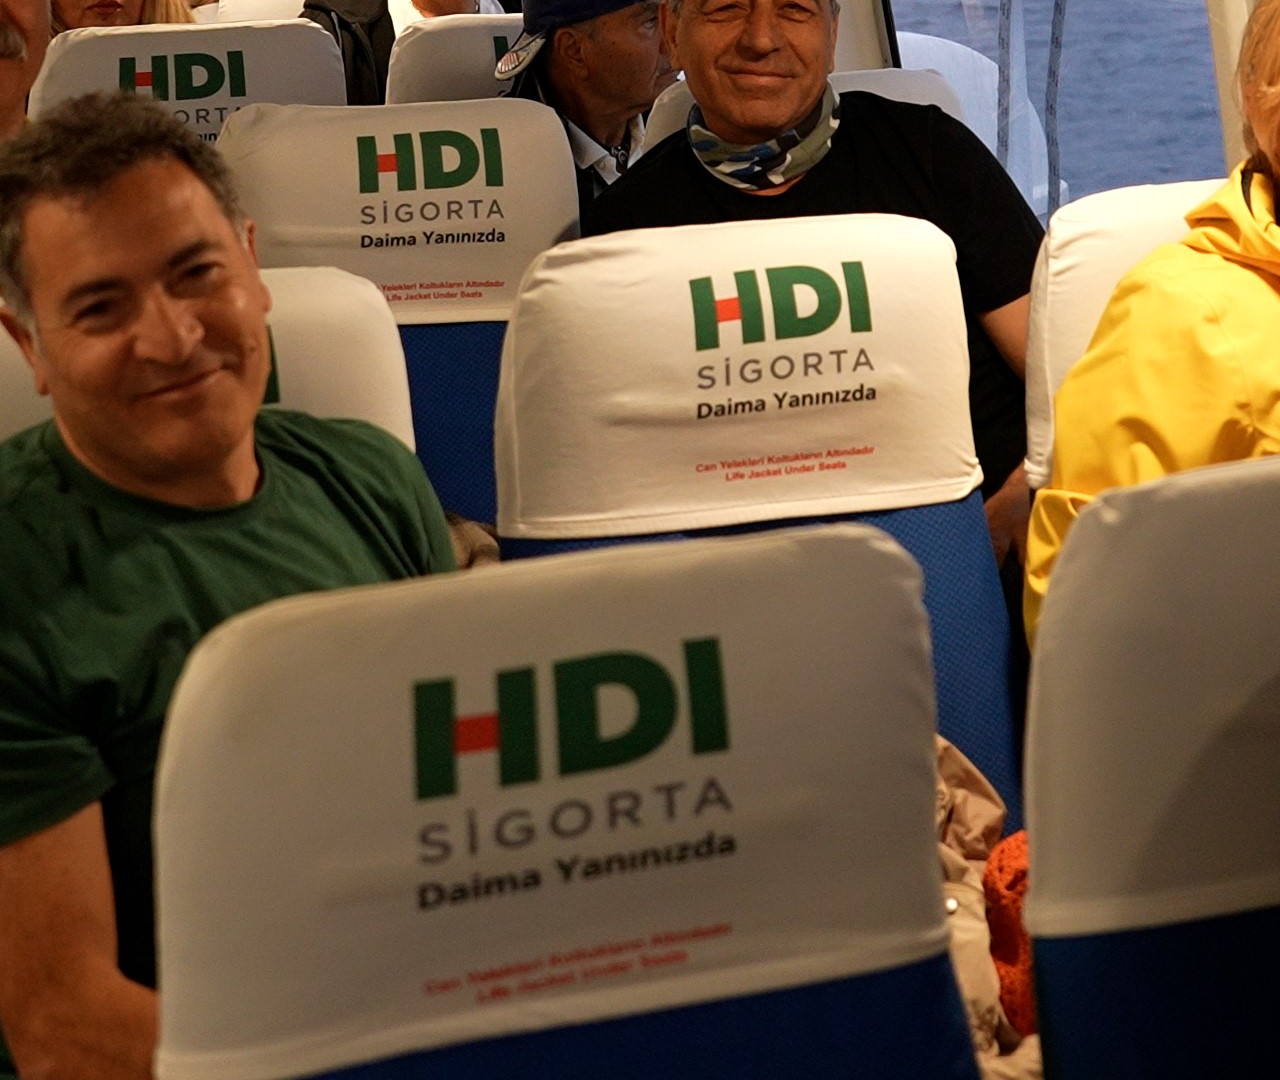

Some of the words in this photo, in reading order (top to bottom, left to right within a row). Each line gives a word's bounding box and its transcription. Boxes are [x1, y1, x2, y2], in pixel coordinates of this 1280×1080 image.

[119, 51, 246, 101] HDI
[356, 128, 504, 194] HDI
[360, 199, 505, 225] SİGORTA
[360, 231, 417, 248] Daima
[422, 229, 505, 246] Yanınızda
[689, 260, 873, 352] HDI
[697, 348, 875, 390] SİGORTA
[697, 398, 766, 420] Daima
[773, 384, 877, 410] Yanınızda
[414, 636, 730, 803] HDI
[419, 776, 734, 867] SİGORTA
[419, 867, 542, 913] Daima
[555, 830, 738, 885] Yanınızda
